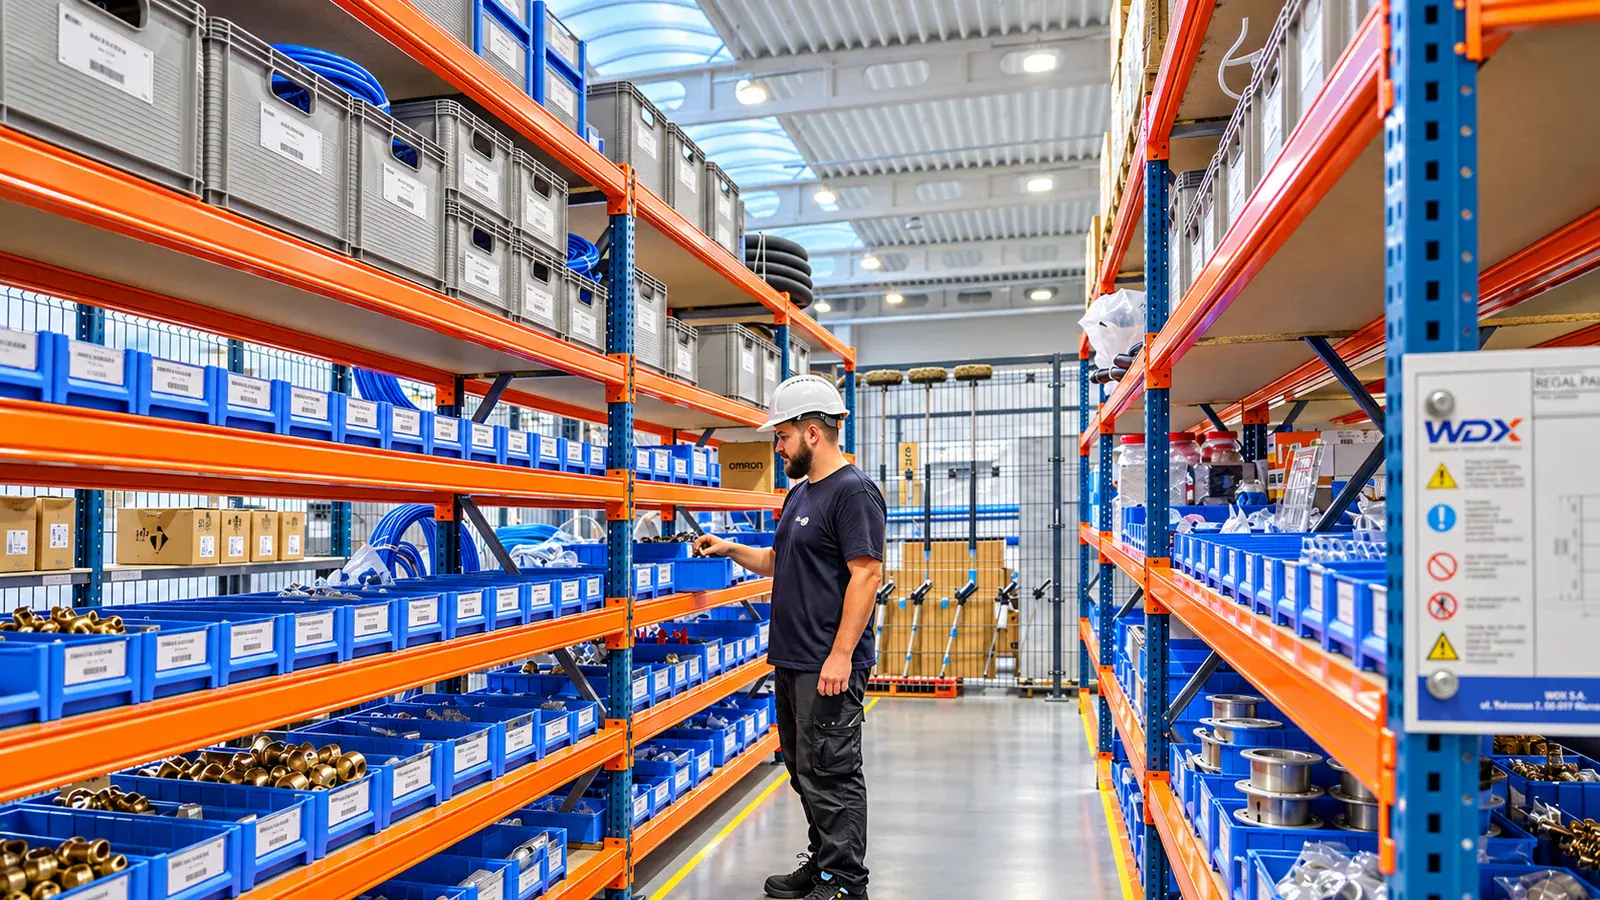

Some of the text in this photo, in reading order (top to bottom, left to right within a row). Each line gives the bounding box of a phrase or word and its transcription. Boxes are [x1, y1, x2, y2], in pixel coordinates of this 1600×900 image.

[1536, 375, 1578, 389] REGAL
[1424, 418, 1522, 443] WDX
[728, 461, 763, 470] OMRON
